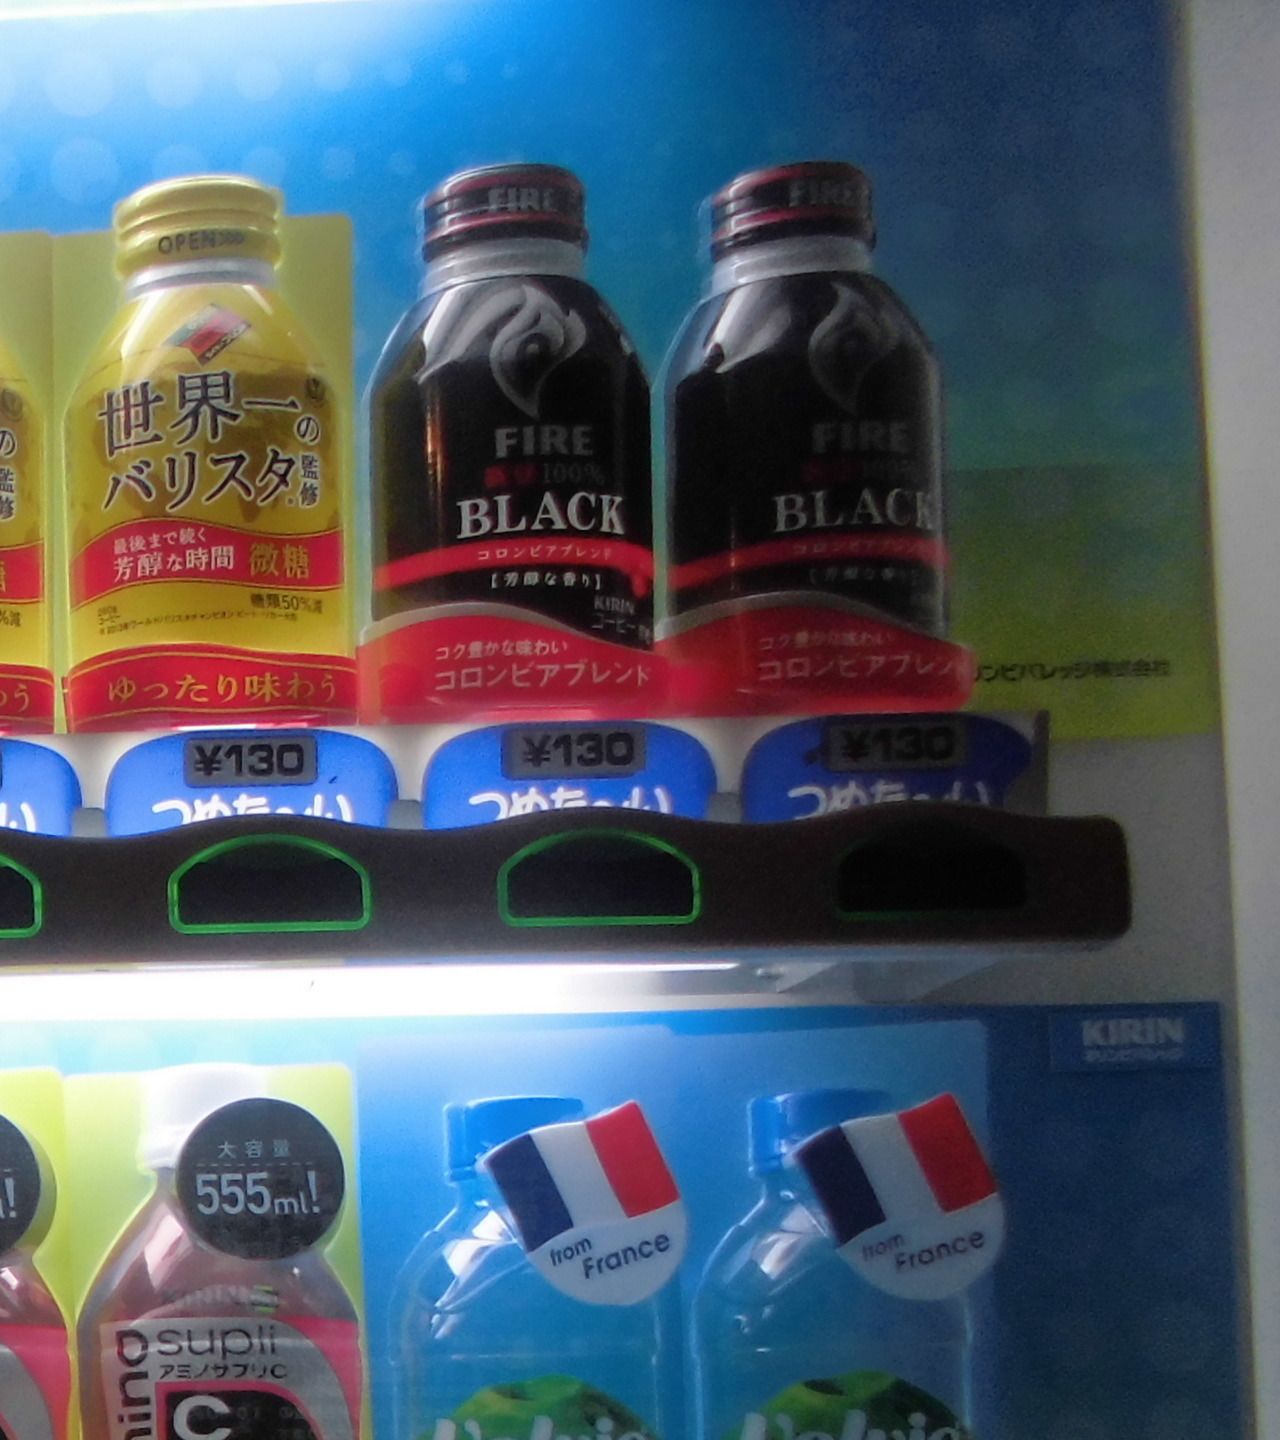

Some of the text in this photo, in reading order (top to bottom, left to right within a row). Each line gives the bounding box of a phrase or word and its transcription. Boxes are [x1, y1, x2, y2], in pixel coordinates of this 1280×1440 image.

[157, 233, 216, 254] OPEN
[496, 426, 593, 457] FIRE
[457, 493, 624, 538] BLACK
[775, 488, 934, 532] BLACK
[114, 527, 207, 555] 最後まで続く
[113, 543, 309, 580] 芳醇な時間 微糖
[108, 673, 337, 702] ゆったり味わう
[434, 663, 649, 692] コロンビアブレンド
[193, 742, 305, 778] ¥130
[523, 733, 634, 769] ¥130
[218, 1140, 290, 1158] 大容量
[196, 1172, 321, 1215] 555ml!
[551, 1239, 592, 1266] from
[582, 1234, 670, 1279] France
[896, 1232, 985, 1273] France
[156, 1326, 276, 1366] supli
